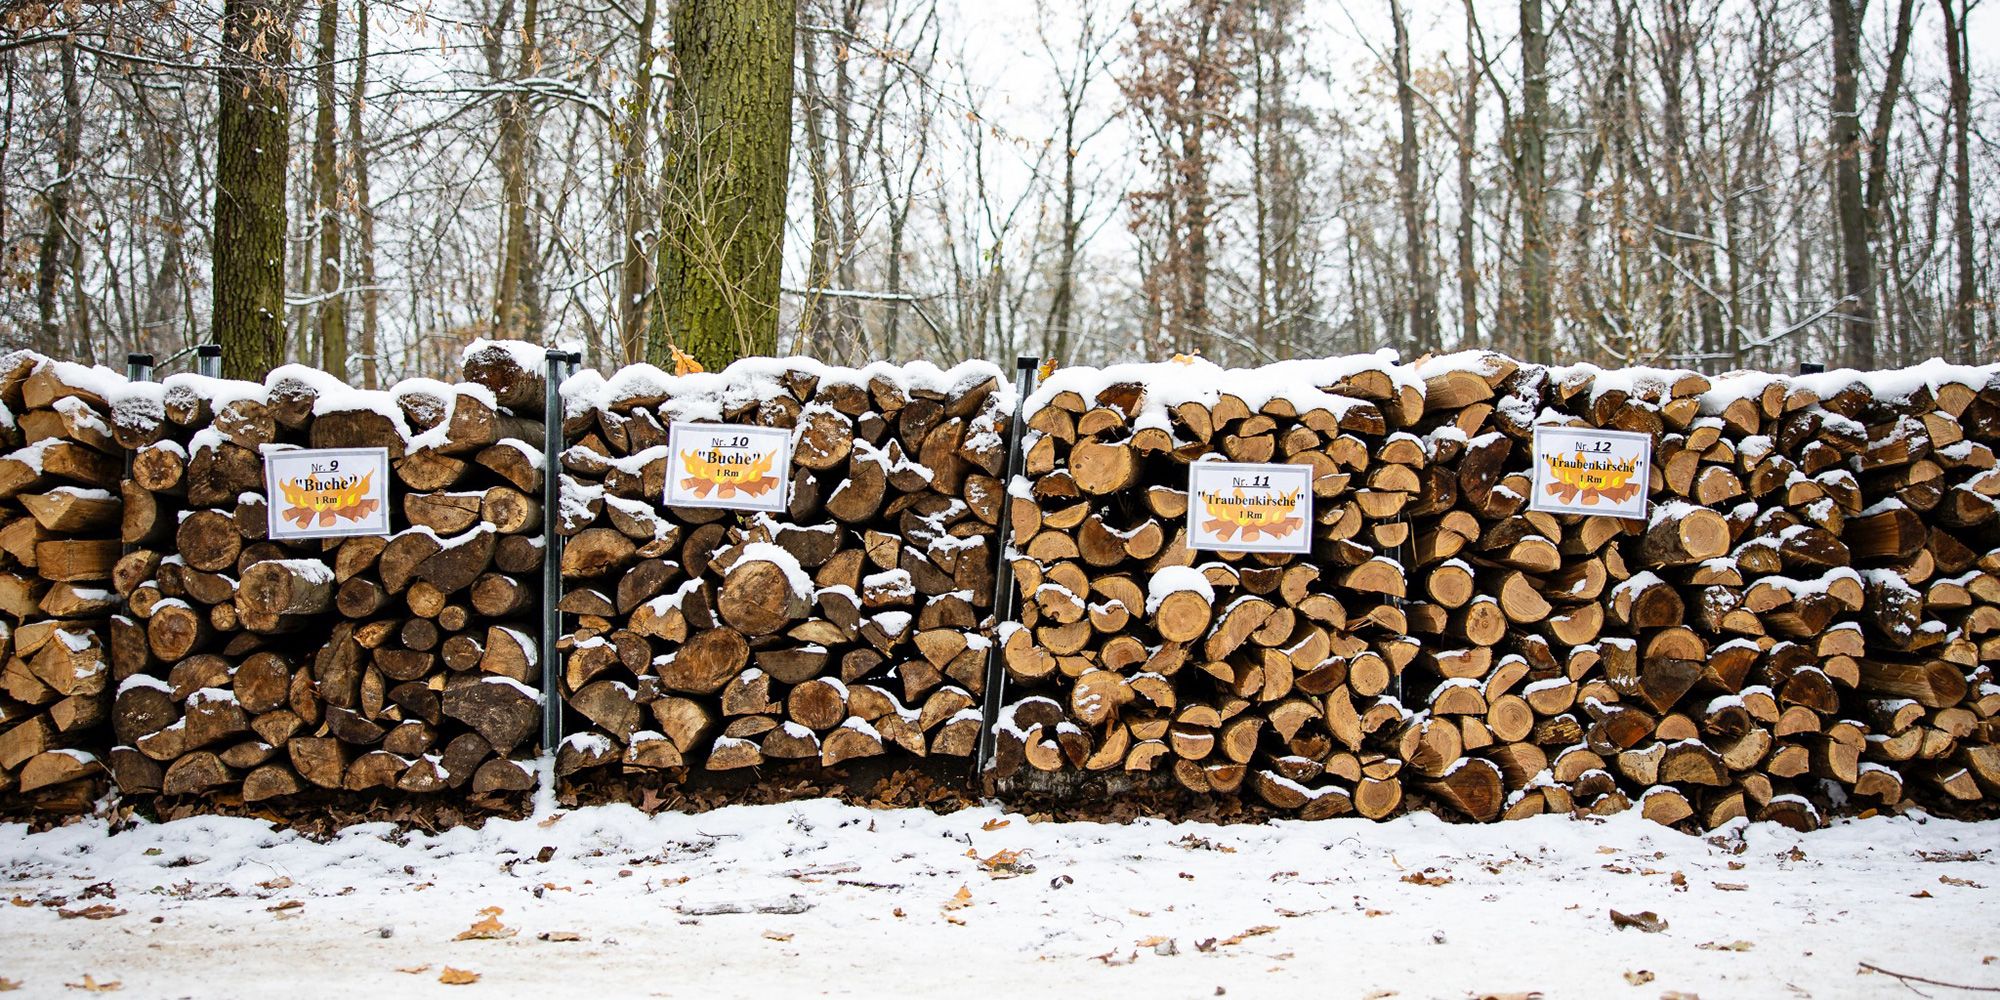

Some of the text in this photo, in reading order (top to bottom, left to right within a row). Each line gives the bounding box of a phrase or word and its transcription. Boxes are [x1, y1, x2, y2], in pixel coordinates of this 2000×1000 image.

[711, 436, 749, 447] Nr. 10
[1575, 441, 1612, 452] Nr. 12
[698, 451, 760, 465] "Buche"
[1541, 453, 1643, 473] "Traubenkirsche"
[311, 460, 339, 472] Nr. 9
[723, 469, 739, 477] Rm
[295, 476, 357, 491] "Buche"
[1232, 475, 1270, 487] Nr. 11
[1579, 474, 1602, 484] 1 Rm
[315, 496, 338, 504] 1 Rm
[1197, 491, 1304, 507] "Traubenkirsche"
[1239, 510, 1262, 519] 1 Rm
